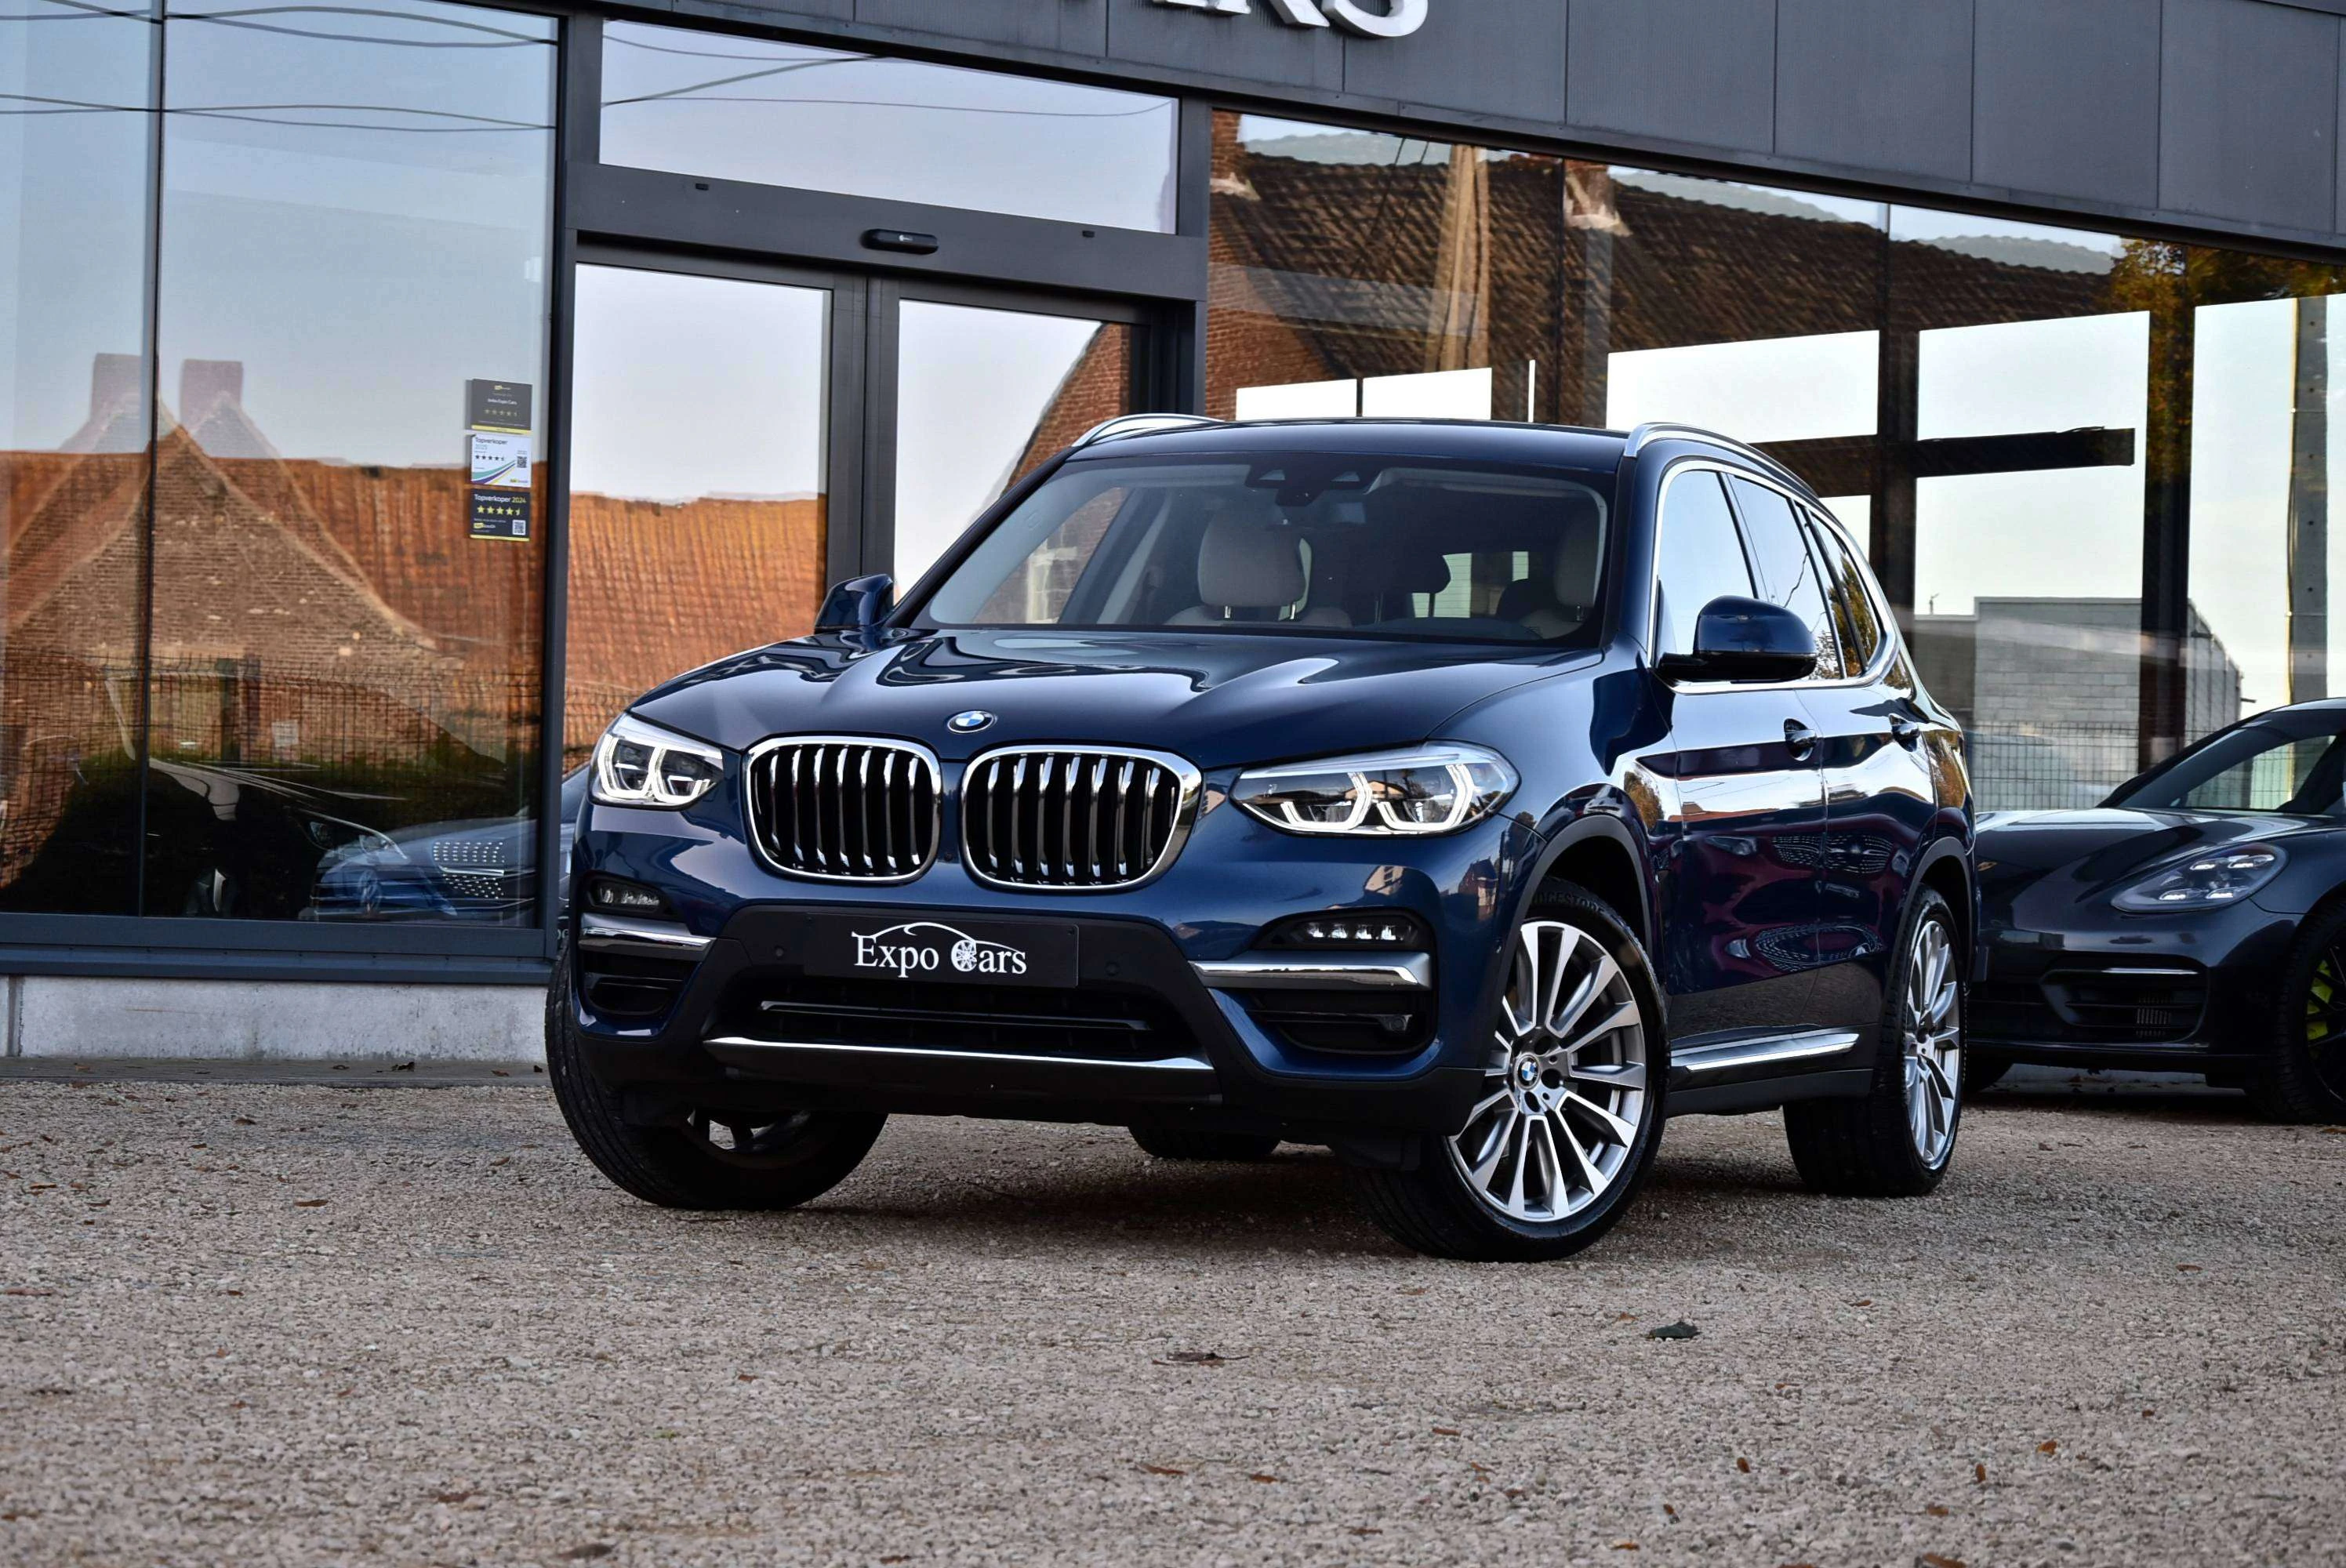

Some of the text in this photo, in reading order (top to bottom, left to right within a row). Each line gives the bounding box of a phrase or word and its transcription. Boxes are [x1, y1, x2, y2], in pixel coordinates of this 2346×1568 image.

[474, 437, 508, 445] Topverkoper
[474, 494, 511, 503] Topverkoper
[854, 935, 1027, 978] Expo Cars
